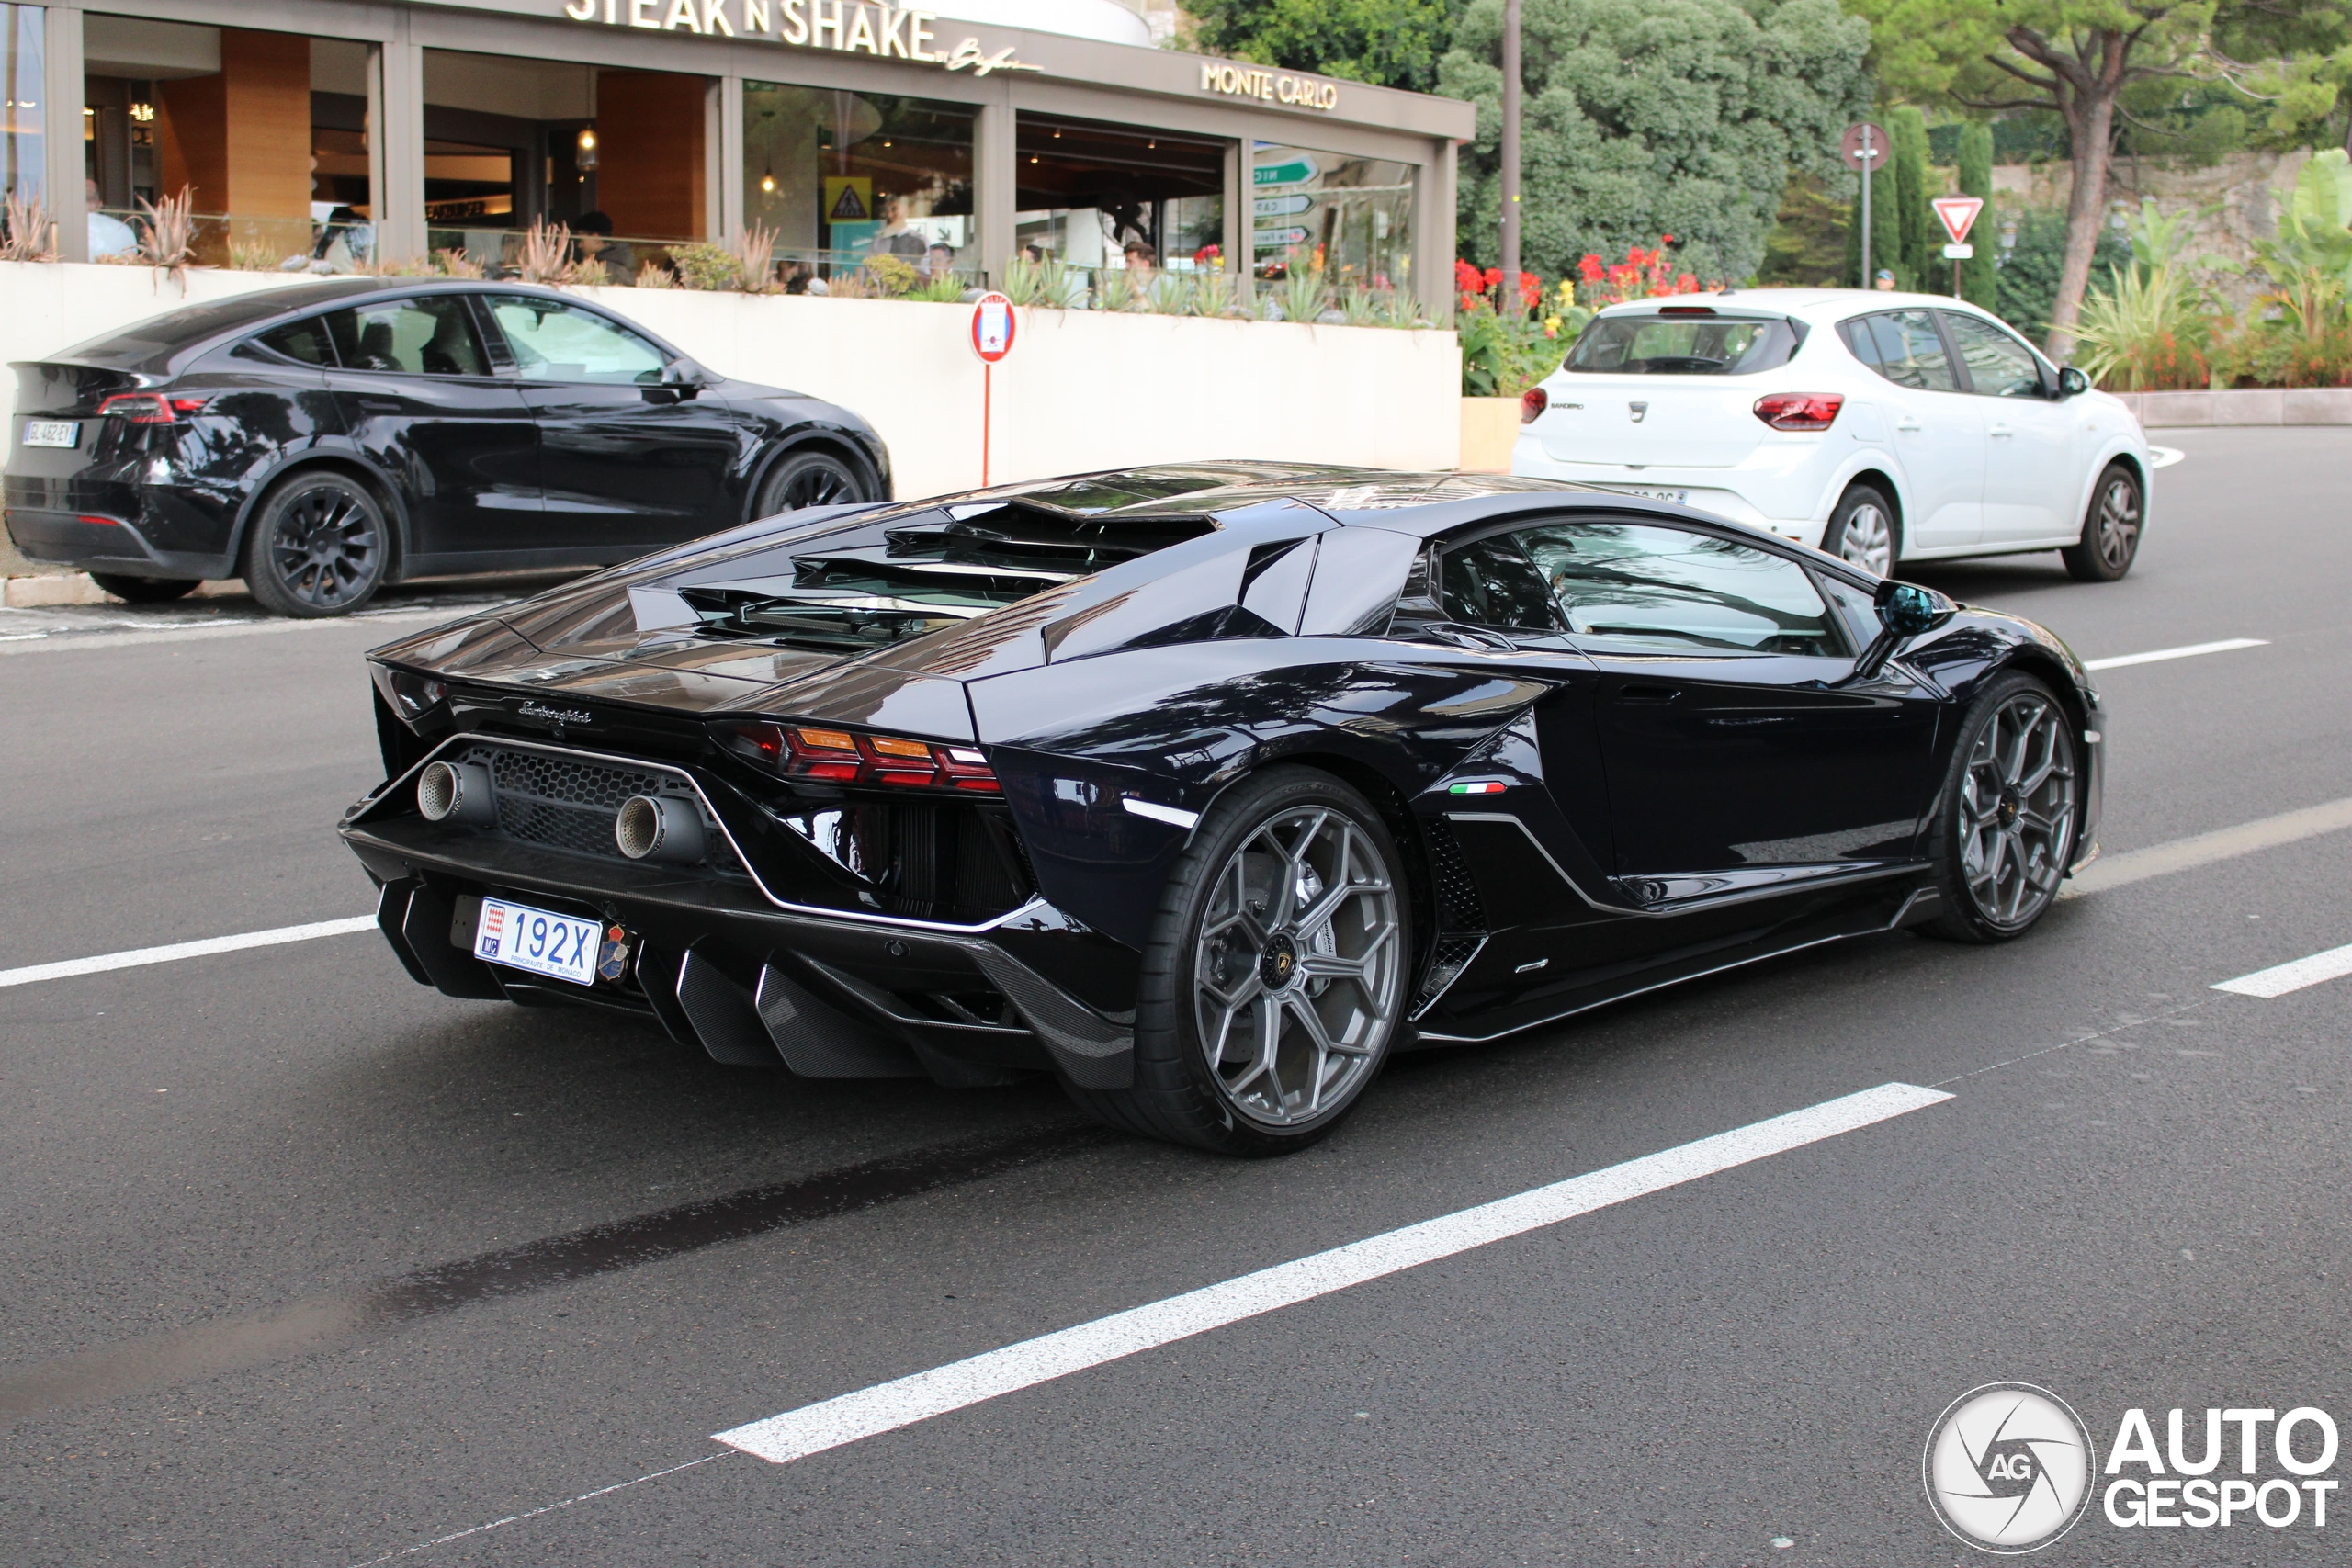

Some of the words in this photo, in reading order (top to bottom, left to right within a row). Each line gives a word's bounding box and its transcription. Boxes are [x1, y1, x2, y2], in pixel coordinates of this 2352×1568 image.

[782, 0, 937, 62] SHAKE
[1201, 62, 1273, 100] MONTE
[1275, 74, 1338, 110] CARLO
[518, 700, 592, 727] Lamborghini
[483, 937, 498, 953] MC
[514, 912, 591, 969] 192X
[546, 963, 554, 972] DE
[557, 965, 582, 978] MONACO
